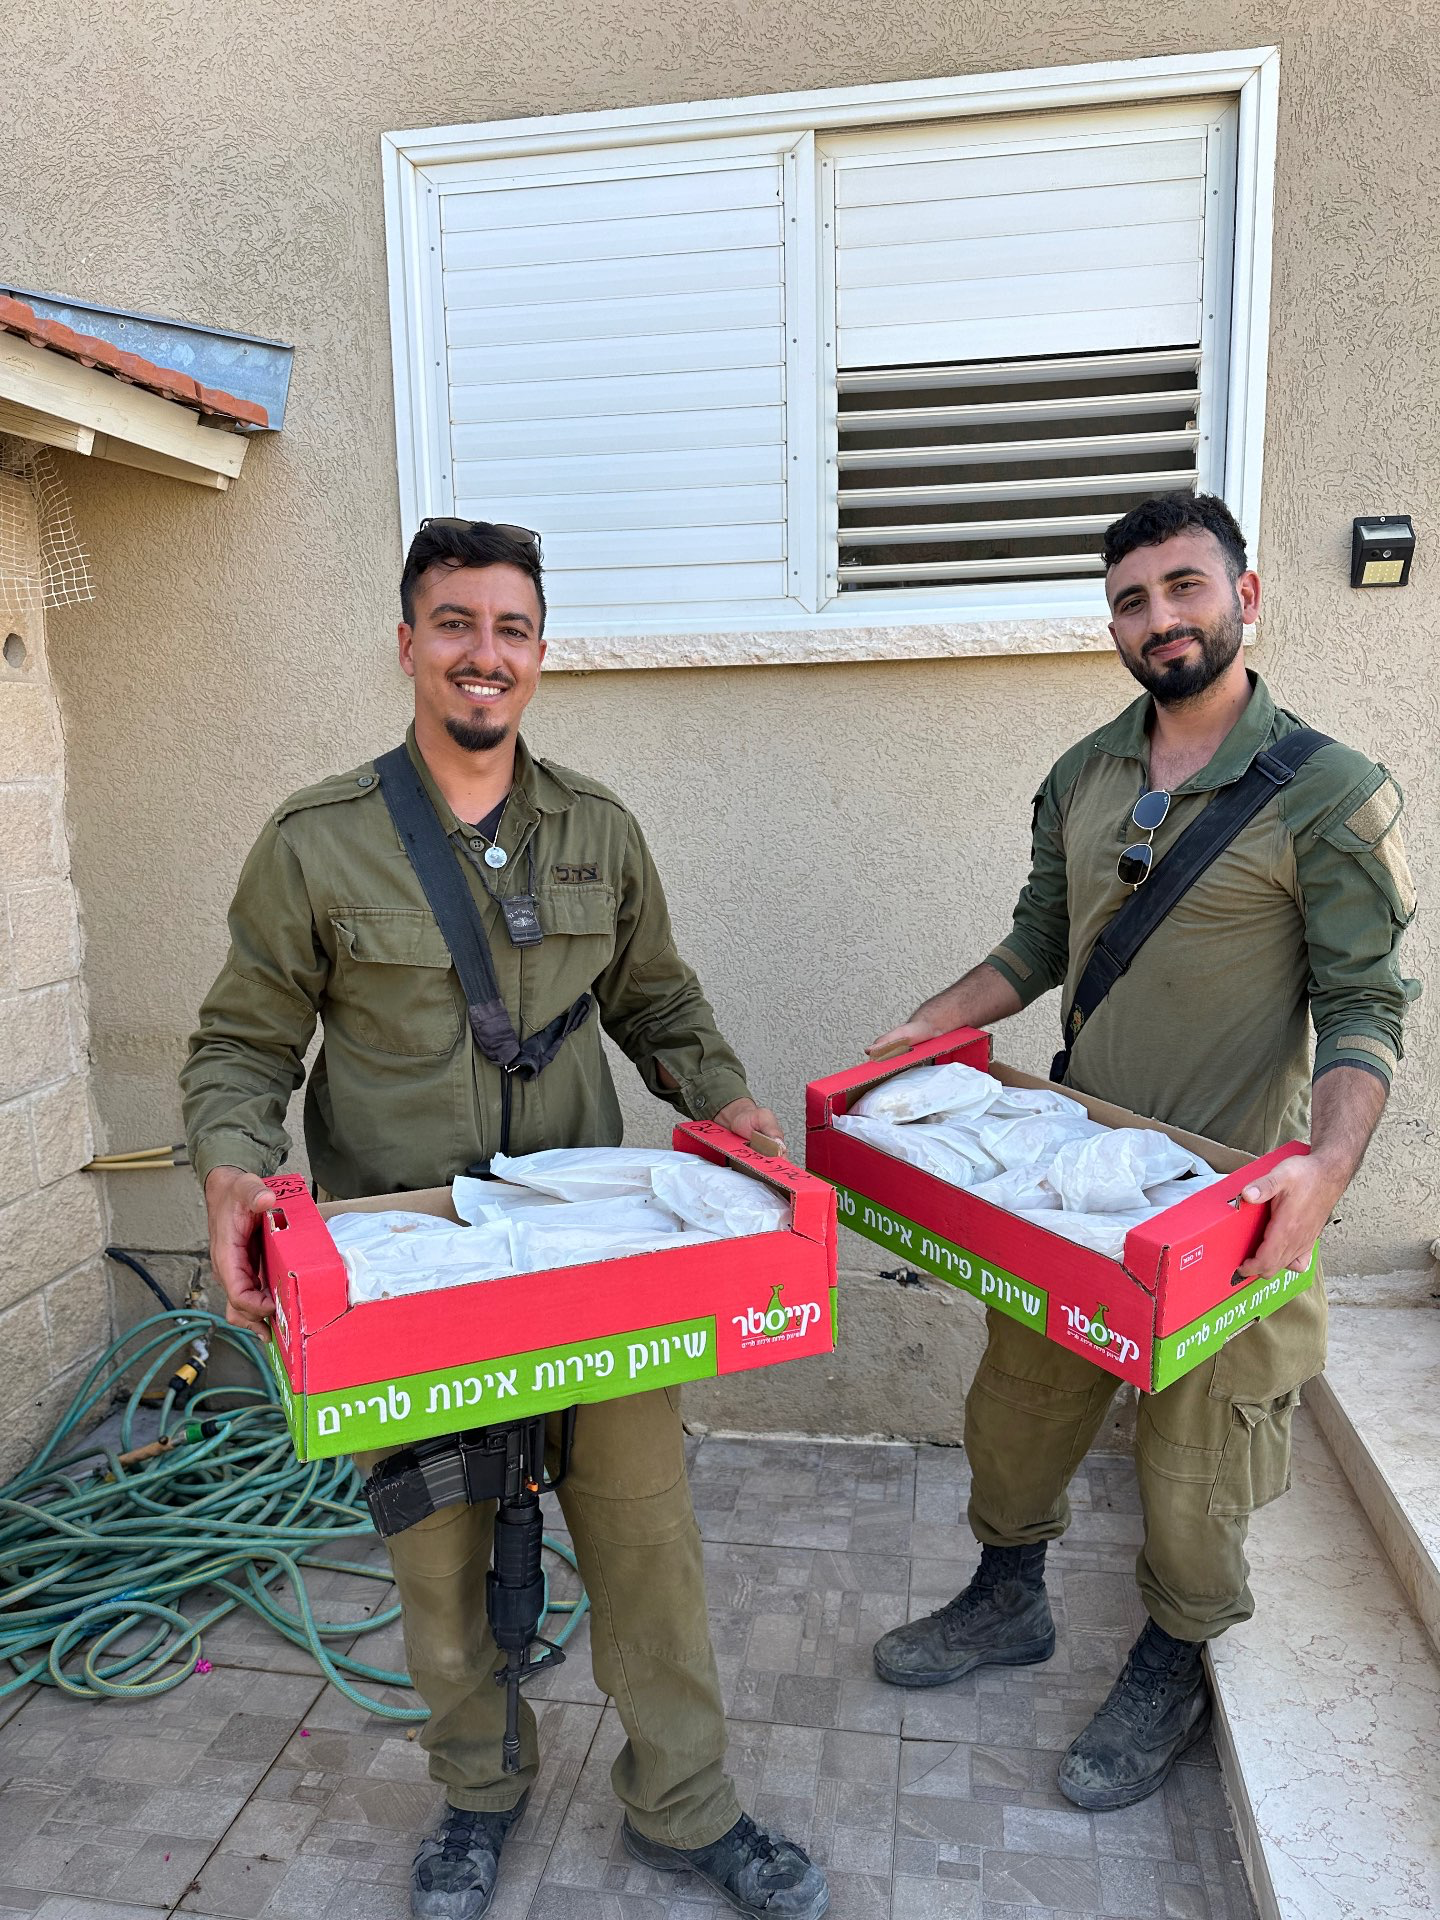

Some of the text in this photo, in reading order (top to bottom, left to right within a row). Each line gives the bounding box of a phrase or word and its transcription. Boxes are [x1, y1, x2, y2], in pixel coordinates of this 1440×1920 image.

[863, 1206, 1041, 1316] שיווק פירות איכות
[1250, 1277, 1281, 1310] פירות
[1213, 1299, 1248, 1335] איכות
[1176, 1323, 1211, 1361] טריים
[317, 1330, 707, 1436] שיווק פירות איכות טריים
